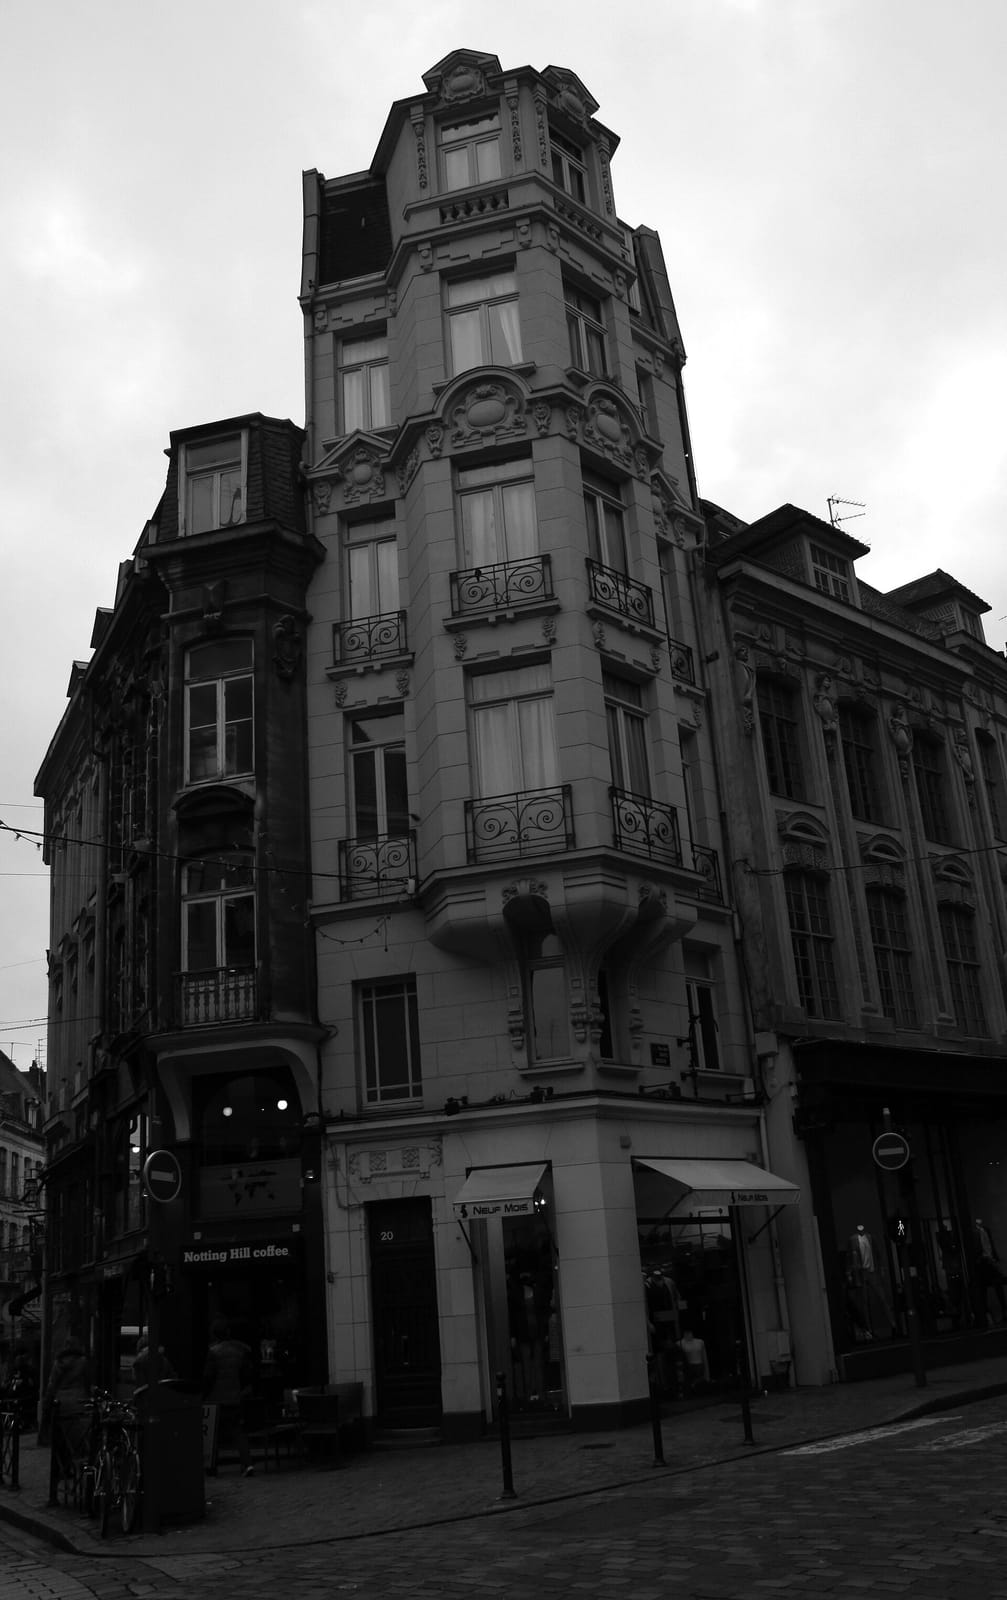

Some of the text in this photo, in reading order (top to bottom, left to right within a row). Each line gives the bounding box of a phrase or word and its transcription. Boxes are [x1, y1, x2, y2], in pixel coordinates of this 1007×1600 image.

[473, 1203, 528, 1215] NEUF MOIS
[380, 1231, 394, 1241] 20
[184, 1245, 289, 1263] Notting Hill coffee
